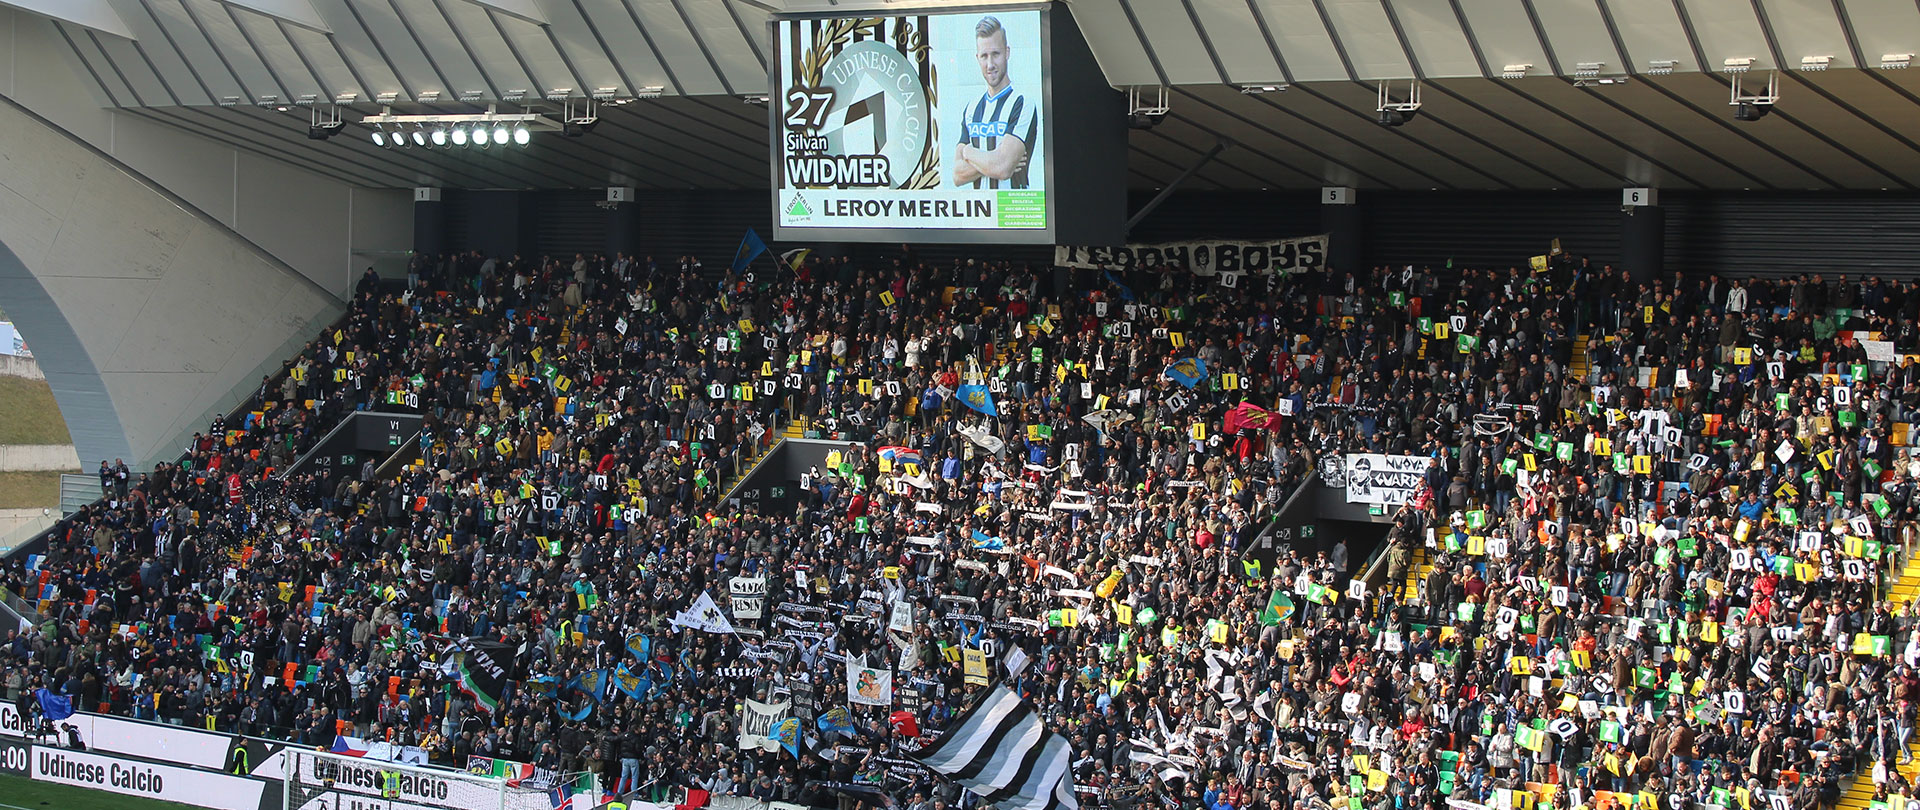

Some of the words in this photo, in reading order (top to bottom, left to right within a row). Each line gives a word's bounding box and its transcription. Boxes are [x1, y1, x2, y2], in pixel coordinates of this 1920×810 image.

[787, 91, 833, 126] 27
[832, 50, 898, 85] UDINESE
[896, 73, 919, 152] CALCIO
[787, 133, 828, 151] Silvan
[788, 157, 889, 184] WIDMER
[1330, 191, 1336, 201] 5
[1632, 192, 1639, 202] 6
[785, 196, 798, 215] LEROY
[824, 199, 893, 217] LEROY
[900, 199, 992, 218] MERLIN
[1215, 241, 1324, 274] BOYS
[390, 421, 399, 430] V1
[1386, 458, 1424, 471] NUOVA
[1375, 473, 1418, 488] GUARD
[1383, 490, 1416, 503] ULTR
[1276, 530, 1283, 538] C2
[40, 752, 108, 785] Udinese
[110, 762, 163, 793] Calcio
[313, 756, 384, 788] Uinese
[400, 773, 448, 800] alcio
